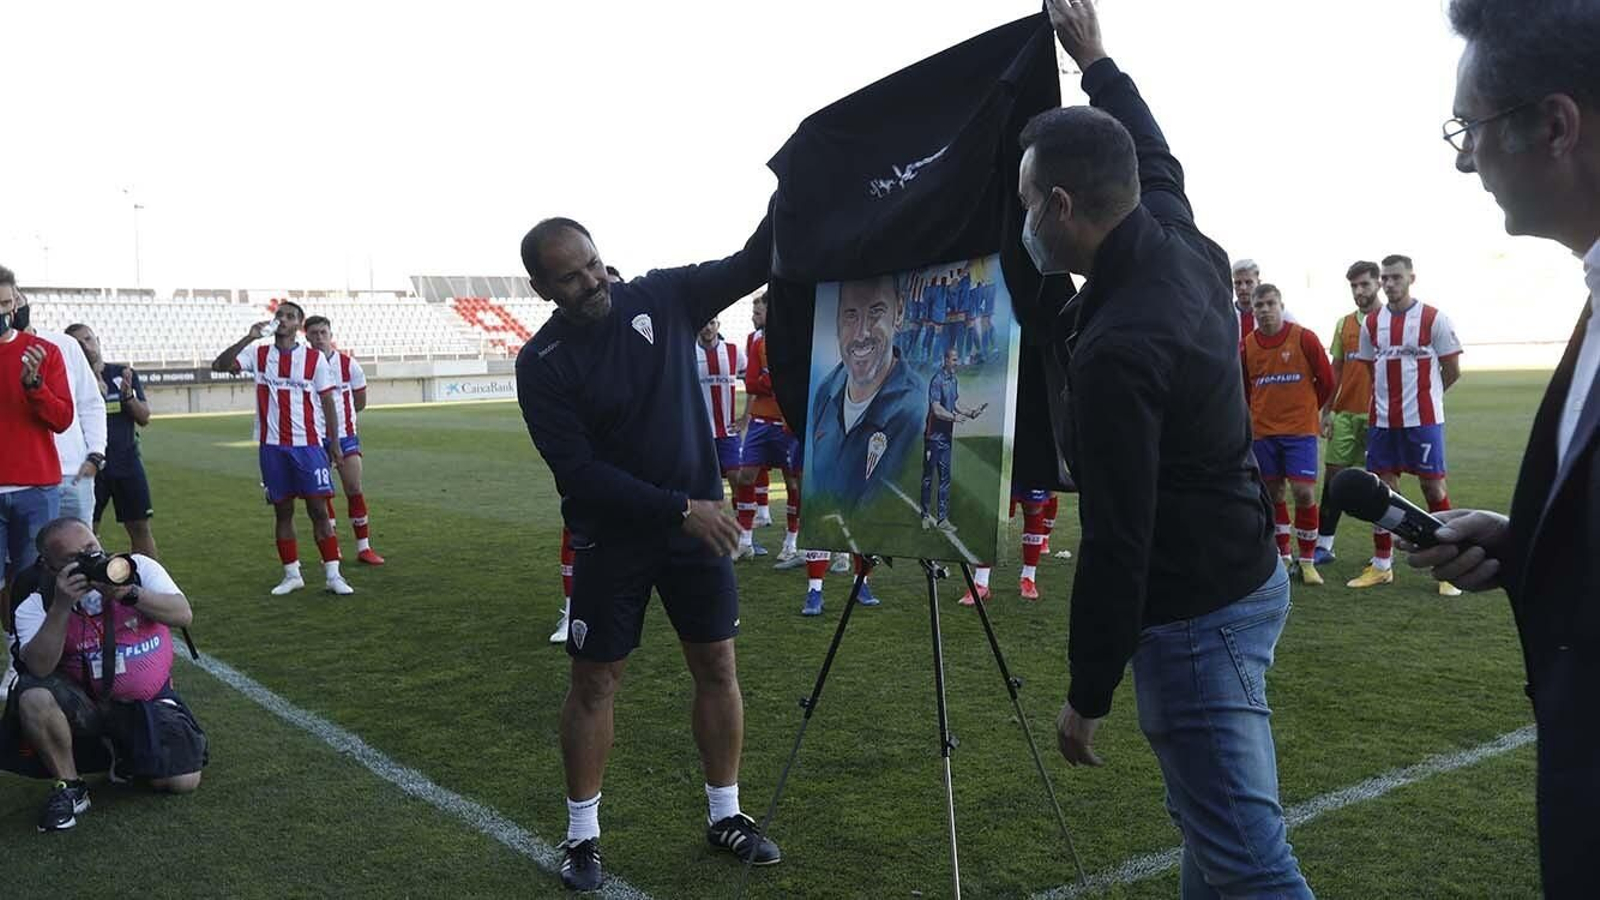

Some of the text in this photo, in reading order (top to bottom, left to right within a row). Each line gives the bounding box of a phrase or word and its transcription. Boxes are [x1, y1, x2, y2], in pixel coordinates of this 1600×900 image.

[150, 372, 163, 382] de
[461, 381, 515, 394] CaixaBank
[1420, 443, 1432, 463] 7
[314, 468, 330, 486] 18
